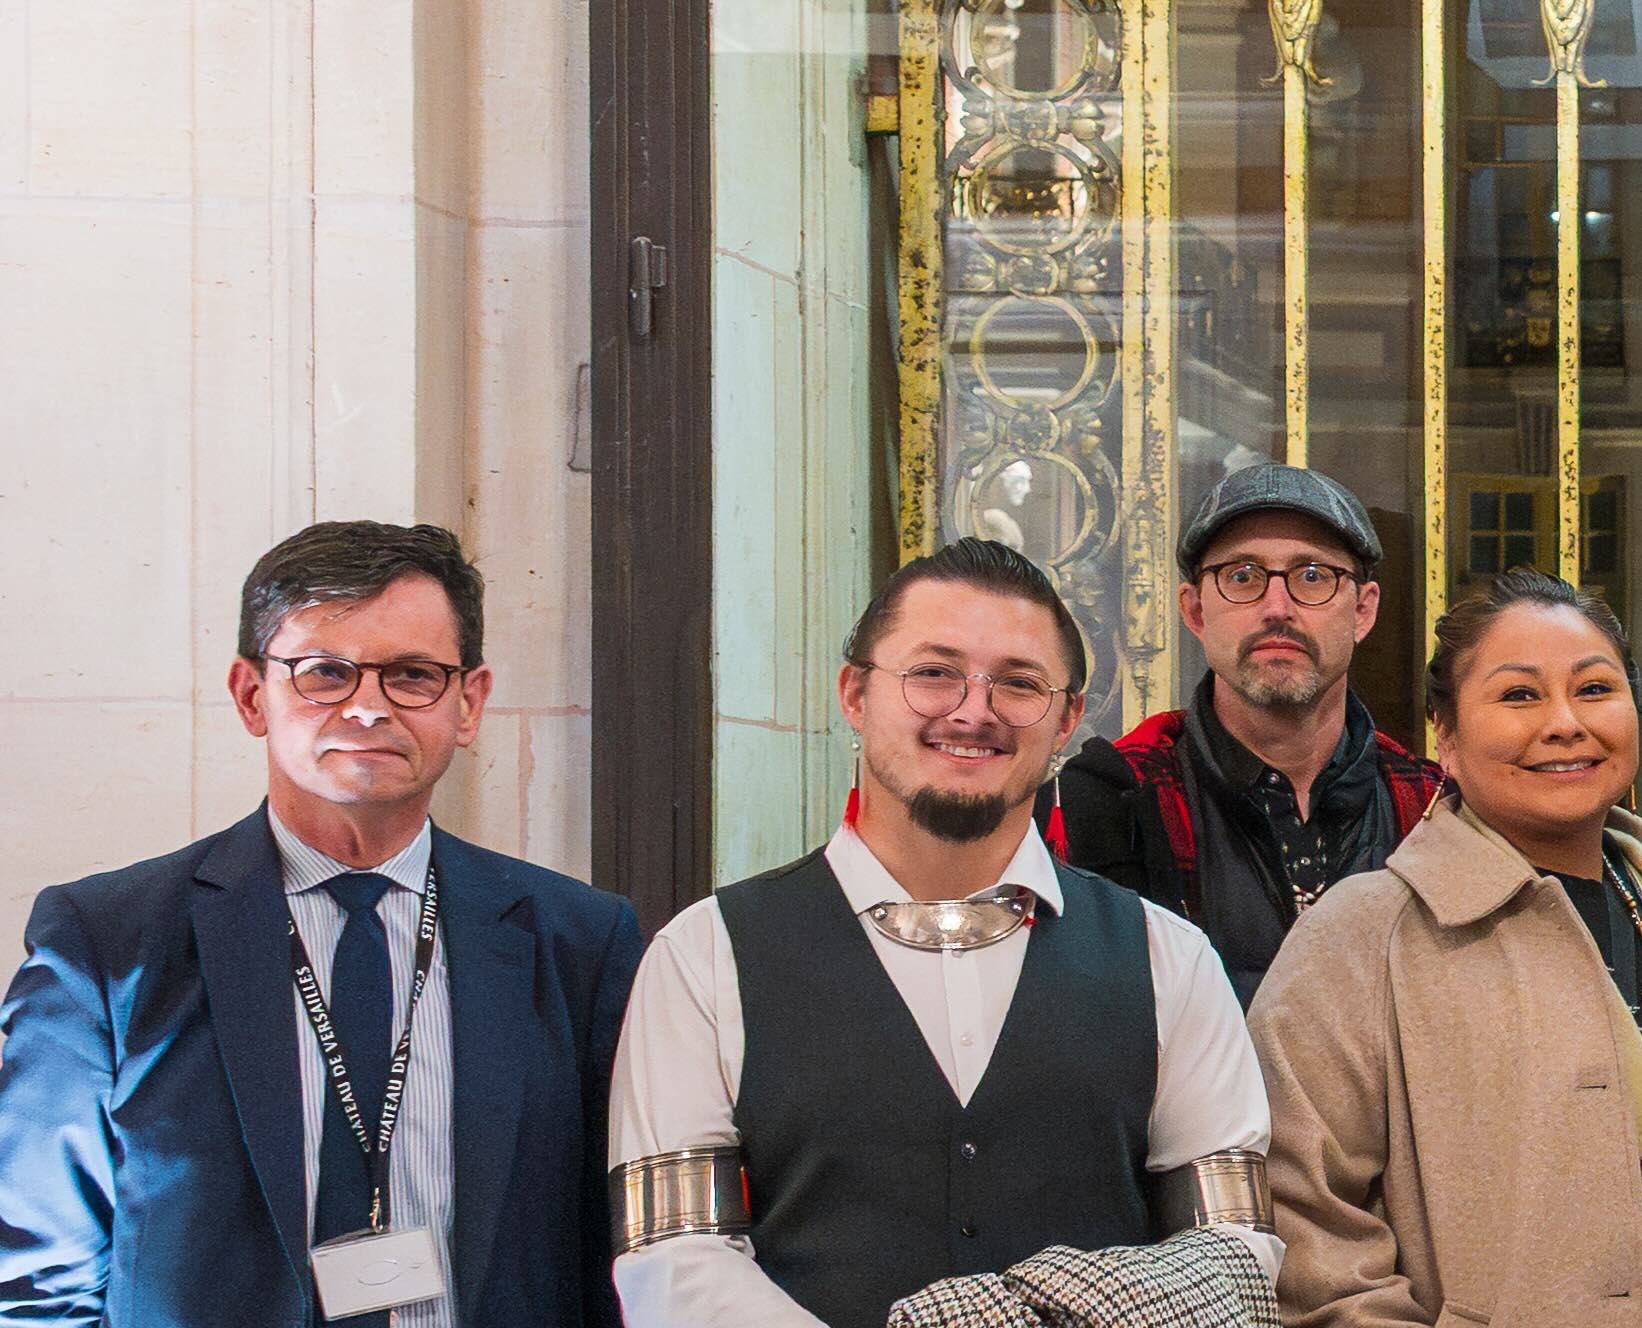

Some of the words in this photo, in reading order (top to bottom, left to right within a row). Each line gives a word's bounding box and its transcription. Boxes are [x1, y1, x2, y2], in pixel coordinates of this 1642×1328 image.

[296, 965, 338, 1053] VERSAILLES
[328, 1054, 347, 1078] DE
[391, 1053, 408, 1073] DE
